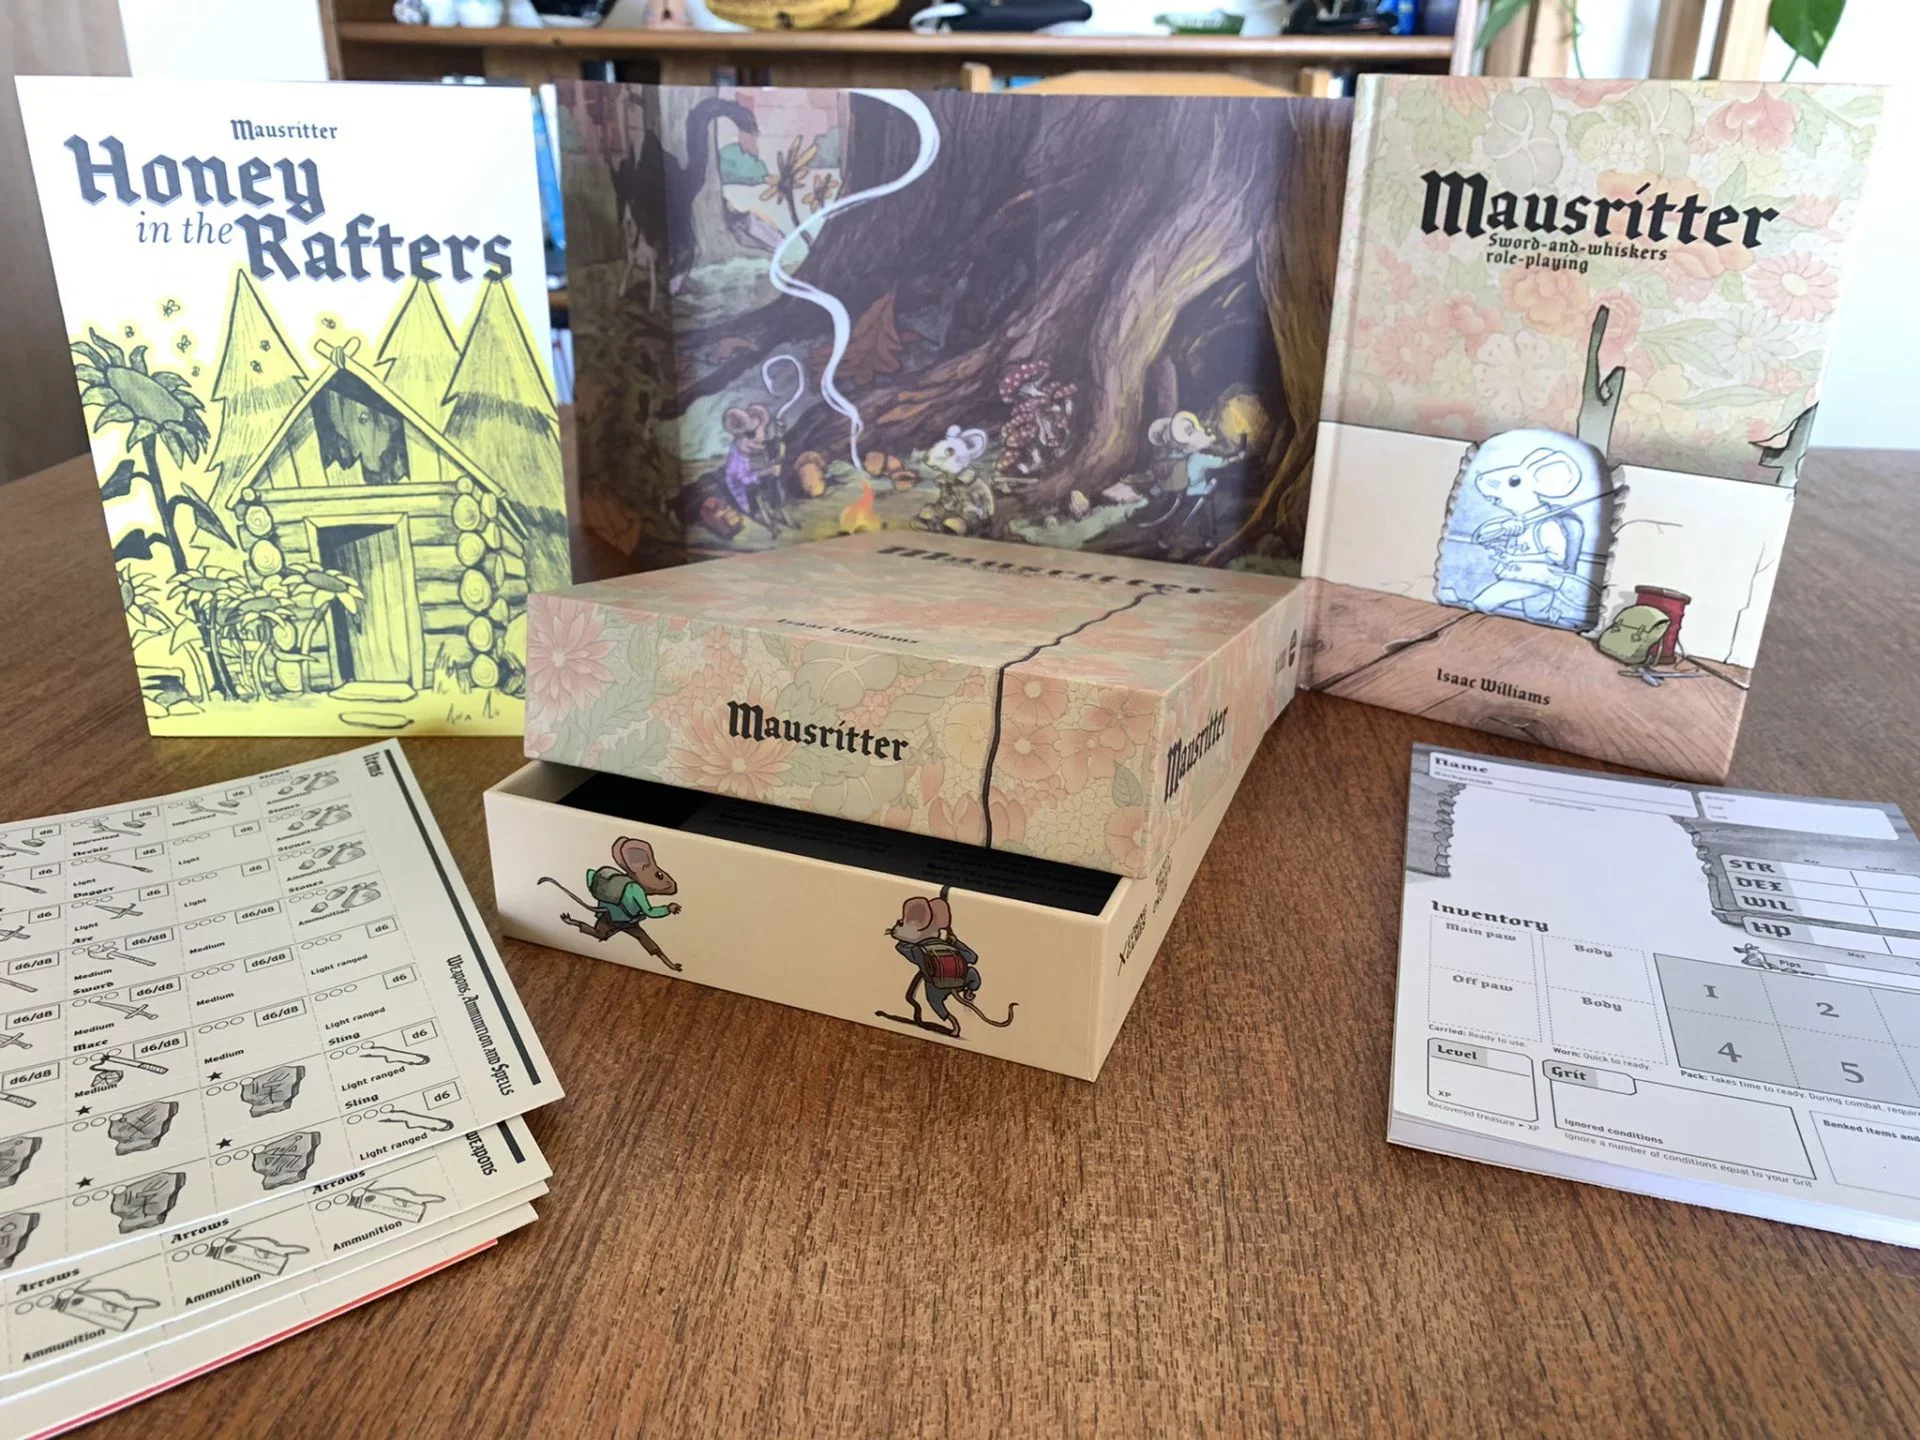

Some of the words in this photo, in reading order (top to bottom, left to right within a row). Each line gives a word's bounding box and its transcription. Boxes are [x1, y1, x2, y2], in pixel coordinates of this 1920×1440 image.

[230, 119, 338, 140] Mausritter
[64, 134, 326, 225] Honey
[1420, 170, 1780, 248] Mausritter
[136, 210, 172, 243] in
[183, 211, 232, 244] the
[234, 212, 513, 285] Rafters
[1488, 234, 1668, 261] Sword-and-whiskers
[1486, 252, 1588, 274] role-playing
[1437, 668, 1477, 688] Isaac
[1480, 678, 1550, 705] Williams
[726, 700, 909, 761] Mausritter
[1164, 706, 1228, 804] Mausritter
[1434, 757, 1489, 774] Name
[178, 856, 200, 866] Light
[249, 864, 263, 872] d6
[1728, 858, 1776, 874] STR
[38, 868, 53, 876] d6
[286, 865, 336, 882] Ammunition
[73, 878, 96, 886] Light
[288, 880, 324, 893] Stones
[1736, 876, 1784, 892] DEX
[147, 888, 162, 896] d6
[184, 898, 207, 908] Light
[1742, 895, 1794, 912] WIL
[37, 911, 52, 919] d6
[242, 905, 274, 920] d6/d8
[298, 908, 350, 926] Ammunition
[1431, 900, 1549, 932] Inventory
[74, 922, 98, 932] Light
[375, 924, 390, 933] d6
[1445, 922, 1483, 936] Main
[1486, 929, 1517, 942] paw
[132, 933, 167, 946] d6/d8
[189, 940, 226, 954] Medium
[1574, 944, 1613, 958] Body
[15, 958, 52, 970] d6/d8
[251, 952, 286, 968] d6/d8
[310, 964, 334, 976] Light
[336, 954, 368, 968] ranged
[74, 968, 112, 980] Medium
[392, 972, 408, 984] d6
[136, 983, 174, 996] d6/d8
[1452, 974, 1478, 986] Off
[1480, 980, 1514, 992] paw
[196, 992, 234, 1006] Medium
[1581, 996, 1622, 1012] Body
[13, 1010, 52, 1024] d6/d8
[262, 1006, 300, 1022] d6/d8
[325, 1018, 350, 1030] Light
[352, 1006, 386, 1022] ranged
[1816, 1002, 1840, 1018] 2
[74, 1022, 114, 1036] Medium
[412, 1028, 428, 1040] d6
[1428, 1024, 1466, 1036] Carried:
[1468, 1031, 1495, 1044] Ready
[1498, 1036, 1507, 1044] to
[73, 1039, 108, 1052] Mace
[140, 1038, 180, 1054] d6/d8
[328, 1031, 360, 1046] Sling
[204, 1048, 244, 1065] Medium
[1437, 1044, 1477, 1060] Level
[1552, 1047, 1581, 1058] Worn:
[1583, 1052, 1609, 1064] Quick
[1611, 1058, 1621, 1066] to
[1717, 1042, 1742, 1063] 4
[10, 1069, 52, 1085] d6/d8
[341, 1077, 370, 1092] Light
[370, 1065, 406, 1082] ranged
[1551, 1066, 1587, 1081] Grit
[1840, 1061, 1865, 1084] 5
[74, 1083, 118, 1098] Medium
[1438, 1090, 1452, 1098] XP
[1680, 1070, 1708, 1081] Pack:
[1710, 1076, 1737, 1086] Takes
[1740, 1080, 1761, 1090] time
[1764, 1085, 1774, 1093] to
[1808, 1093, 1842, 1105] During
[344, 1093, 380, 1110] Sling
[434, 1090, 450, 1102] d6
[1428, 1100, 1474, 1118] Recovered
[1477, 1112, 1515, 1127] treasure
[1528, 1124, 1540, 1132] XP
[1564, 1118, 1605, 1132] Ignored
[1608, 1128, 1664, 1144] conditions
[1823, 1120, 1863, 1132] Banked
[1866, 1127, 1898, 1138] items
[360, 1145, 388, 1160] Light
[391, 1132, 428, 1150] ranged
[1564, 1132, 1597, 1146] Ignore
[1608, 1141, 1647, 1156] number
[1650, 1150, 1662, 1158] of
[1663, 1153, 1718, 1170] conditions
[1720, 1163, 1750, 1177] equal
[1752, 1170, 1763, 1178] to
[1765, 1173, 1790, 1184] your
[1792, 1176, 1813, 1188] Grit
[312, 1170, 366, 1194] Arrows
[171, 1218, 229, 1244] Arrows
[332, 1220, 402, 1252] Ammunition
[16, 1268, 80, 1295] Arrows
[185, 1272, 262, 1306] Ammunition
[23, 1328, 106, 1362] Ammunition
